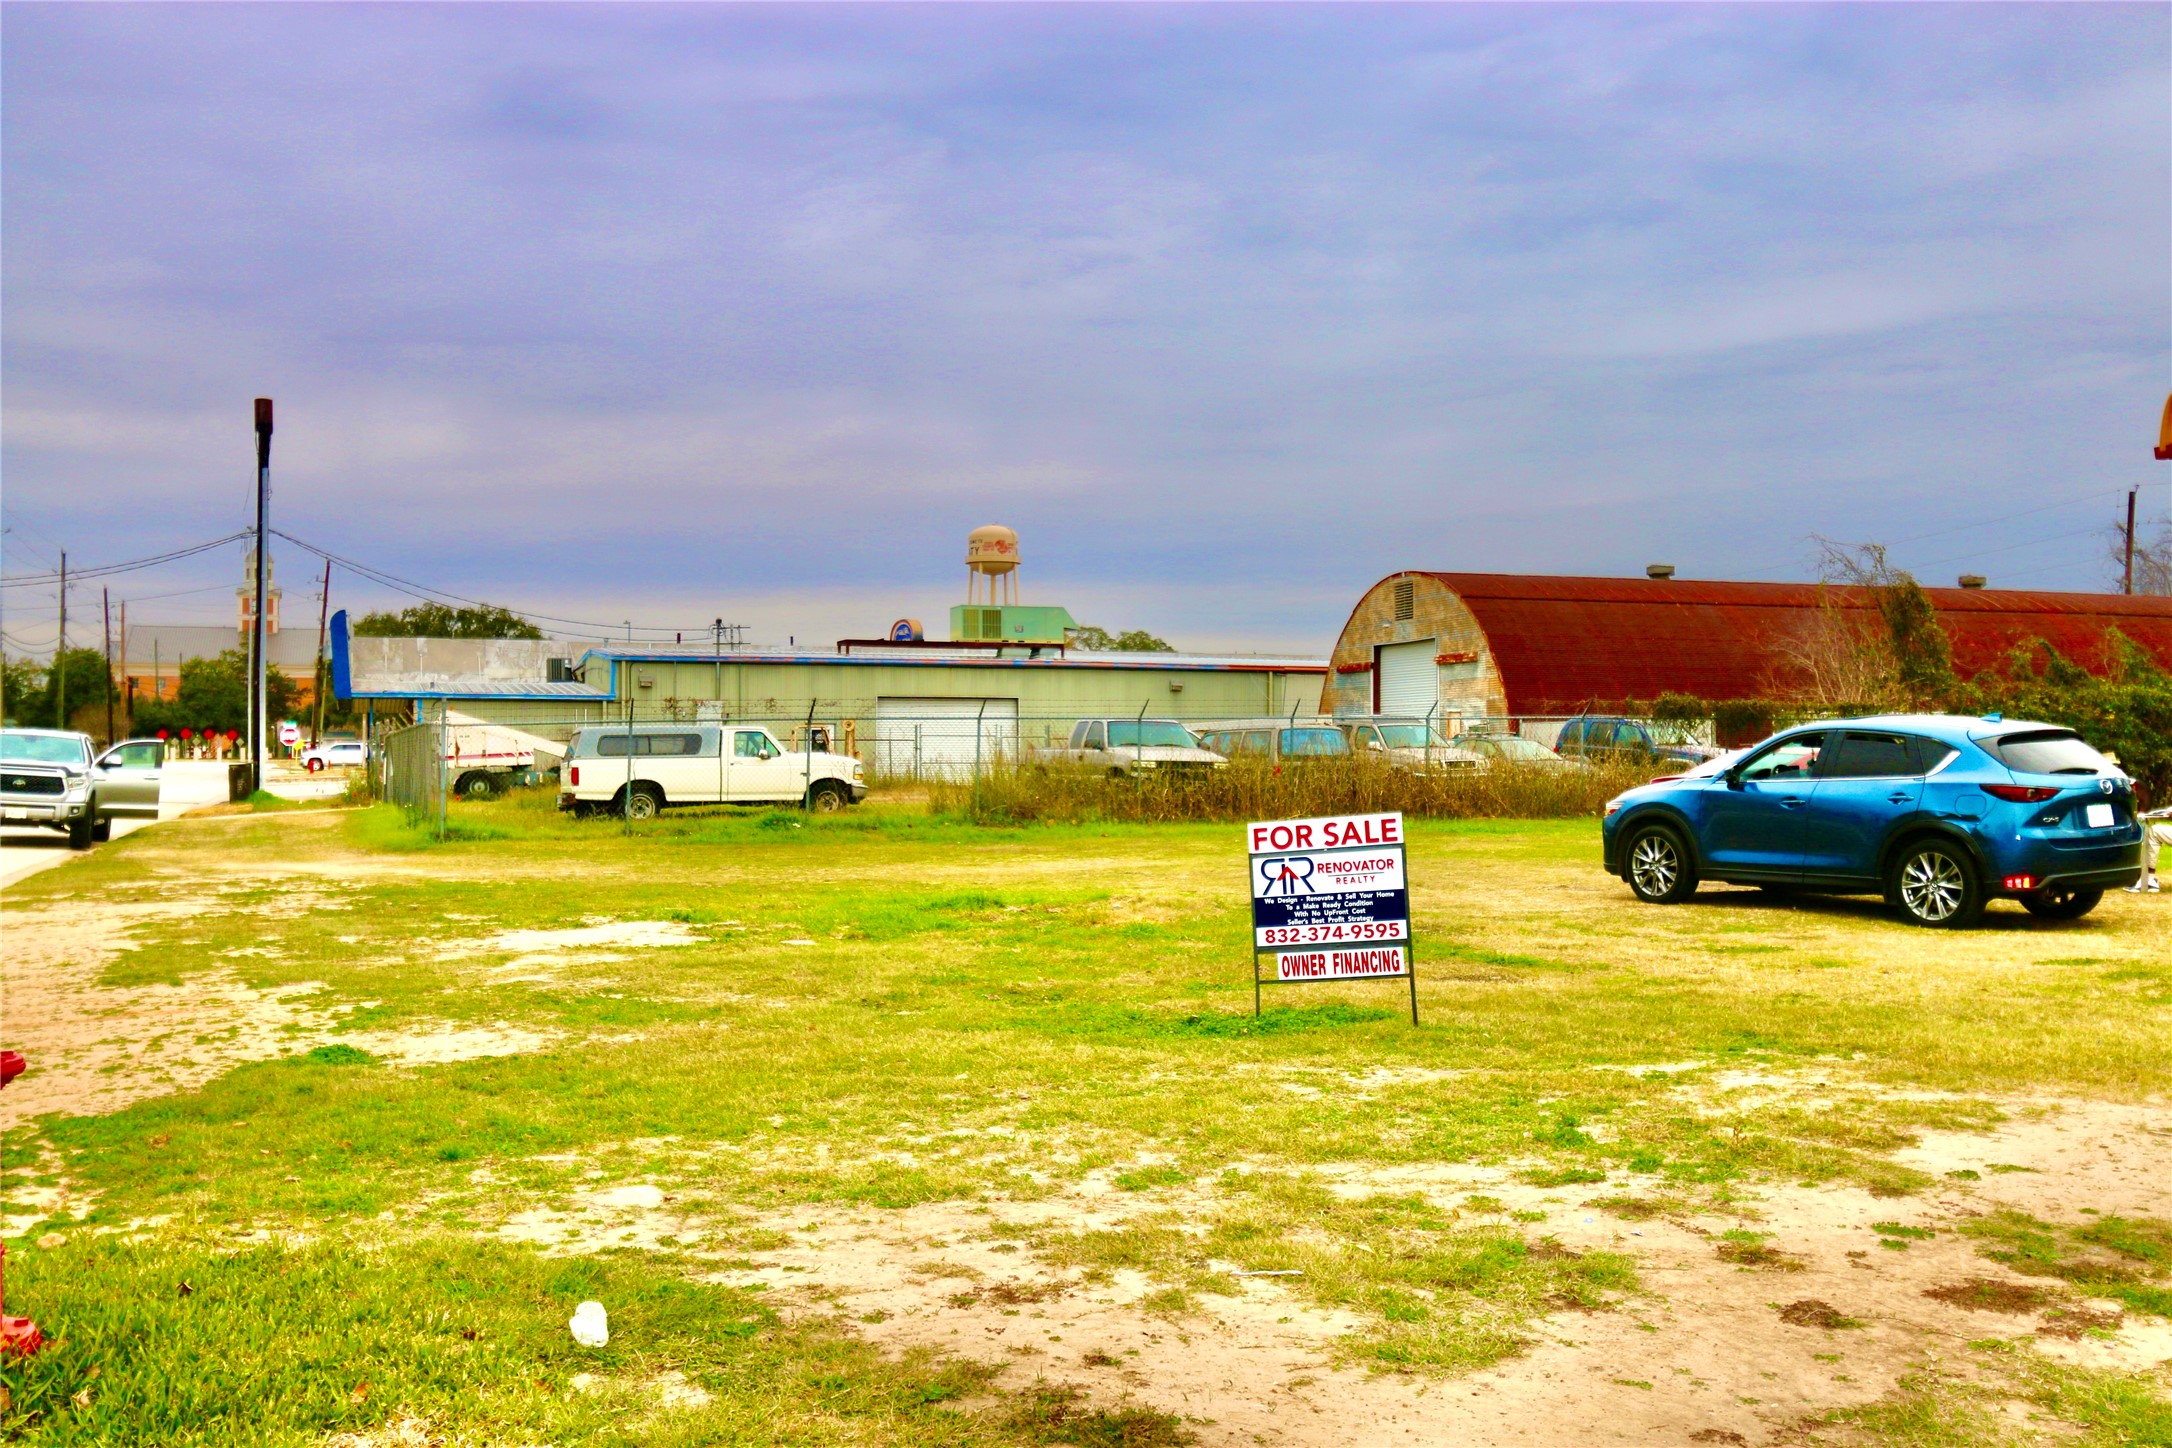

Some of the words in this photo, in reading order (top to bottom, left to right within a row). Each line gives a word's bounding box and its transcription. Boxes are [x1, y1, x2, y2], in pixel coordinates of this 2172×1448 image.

[1253, 824, 1313, 851] FOR
[1323, 818, 1398, 847] SALE
[1317, 858, 1394, 874] RENOVATOR
[1336, 875, 1376, 885] REALTY
[1277, 897, 1298, 905] Design
[1345, 892, 1356, 900] Sell
[1322, 901, 1341, 909] Ready
[1344, 899, 1374, 907] Condition
[1348, 915, 1374, 923] Strategy
[1265, 922, 1400, 944] 832-374-9595
[1281, 953, 1326, 978] OWNER
[1332, 949, 1400, 975] FINANCING
